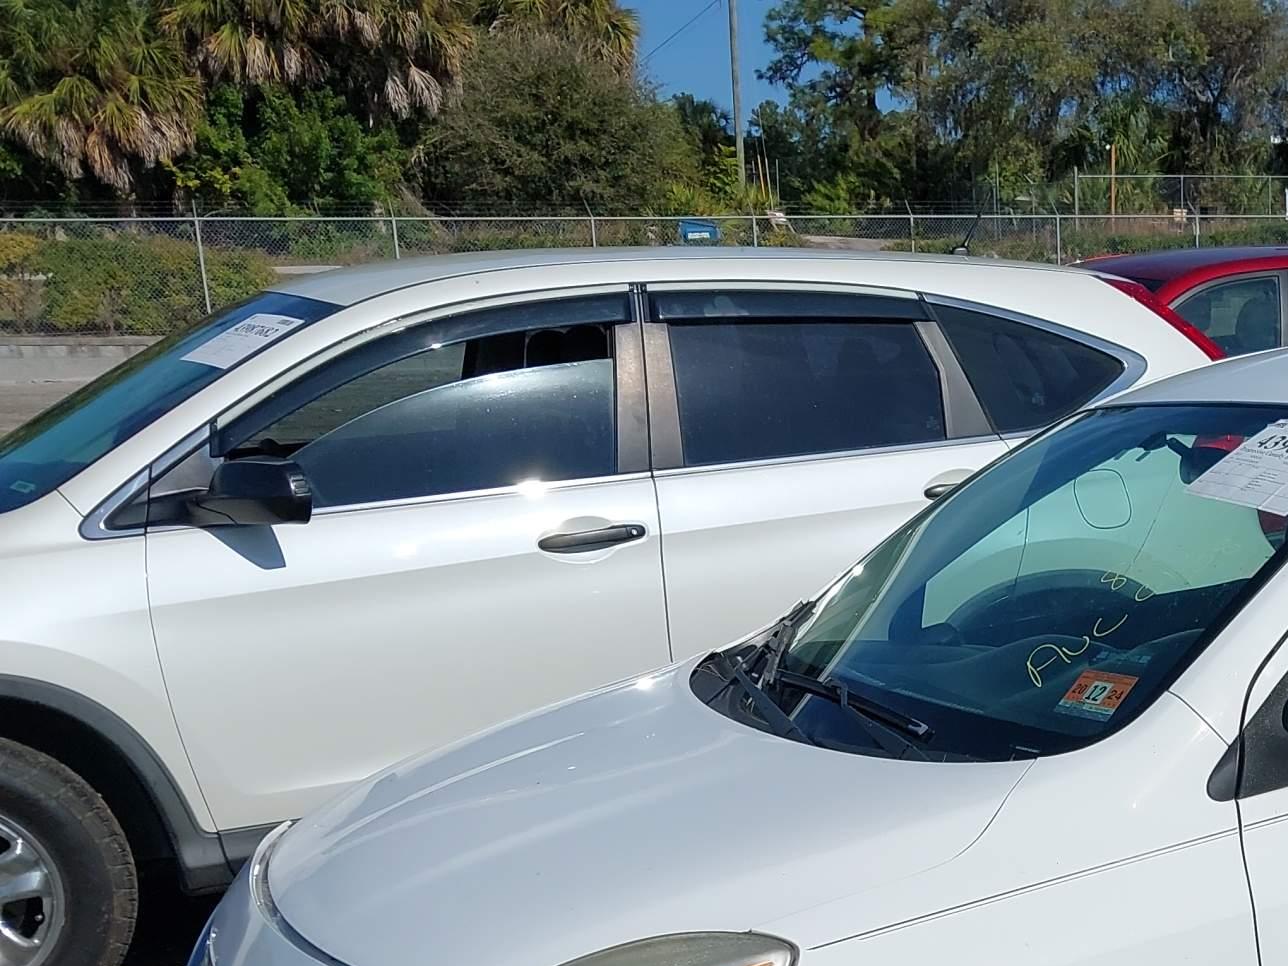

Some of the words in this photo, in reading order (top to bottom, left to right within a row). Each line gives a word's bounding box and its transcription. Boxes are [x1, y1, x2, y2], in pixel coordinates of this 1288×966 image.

[1072, 683, 1089, 694] 20
[1084, 684, 1108, 702] 12
[1107, 689, 1124, 700] 24
